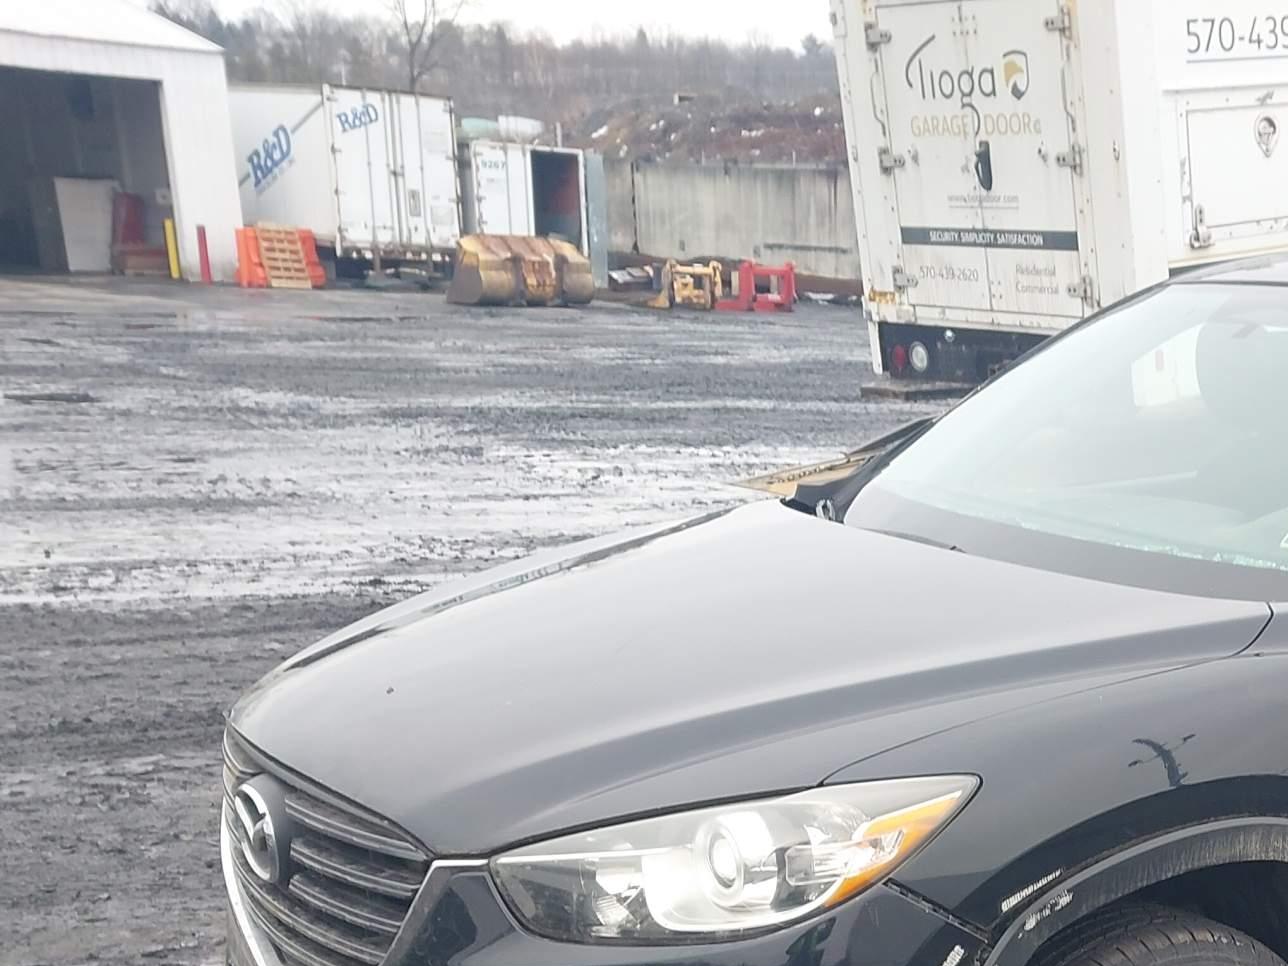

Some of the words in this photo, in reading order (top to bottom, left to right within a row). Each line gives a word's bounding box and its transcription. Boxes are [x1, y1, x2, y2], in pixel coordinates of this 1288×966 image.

[905, 34, 996, 137] Tioga
[336, 103, 380, 133] R&D
[910, 114, 969, 138] GARAGE
[247, 124, 292, 188] R&D
[919, 264, 980, 283] 570-439-2620
